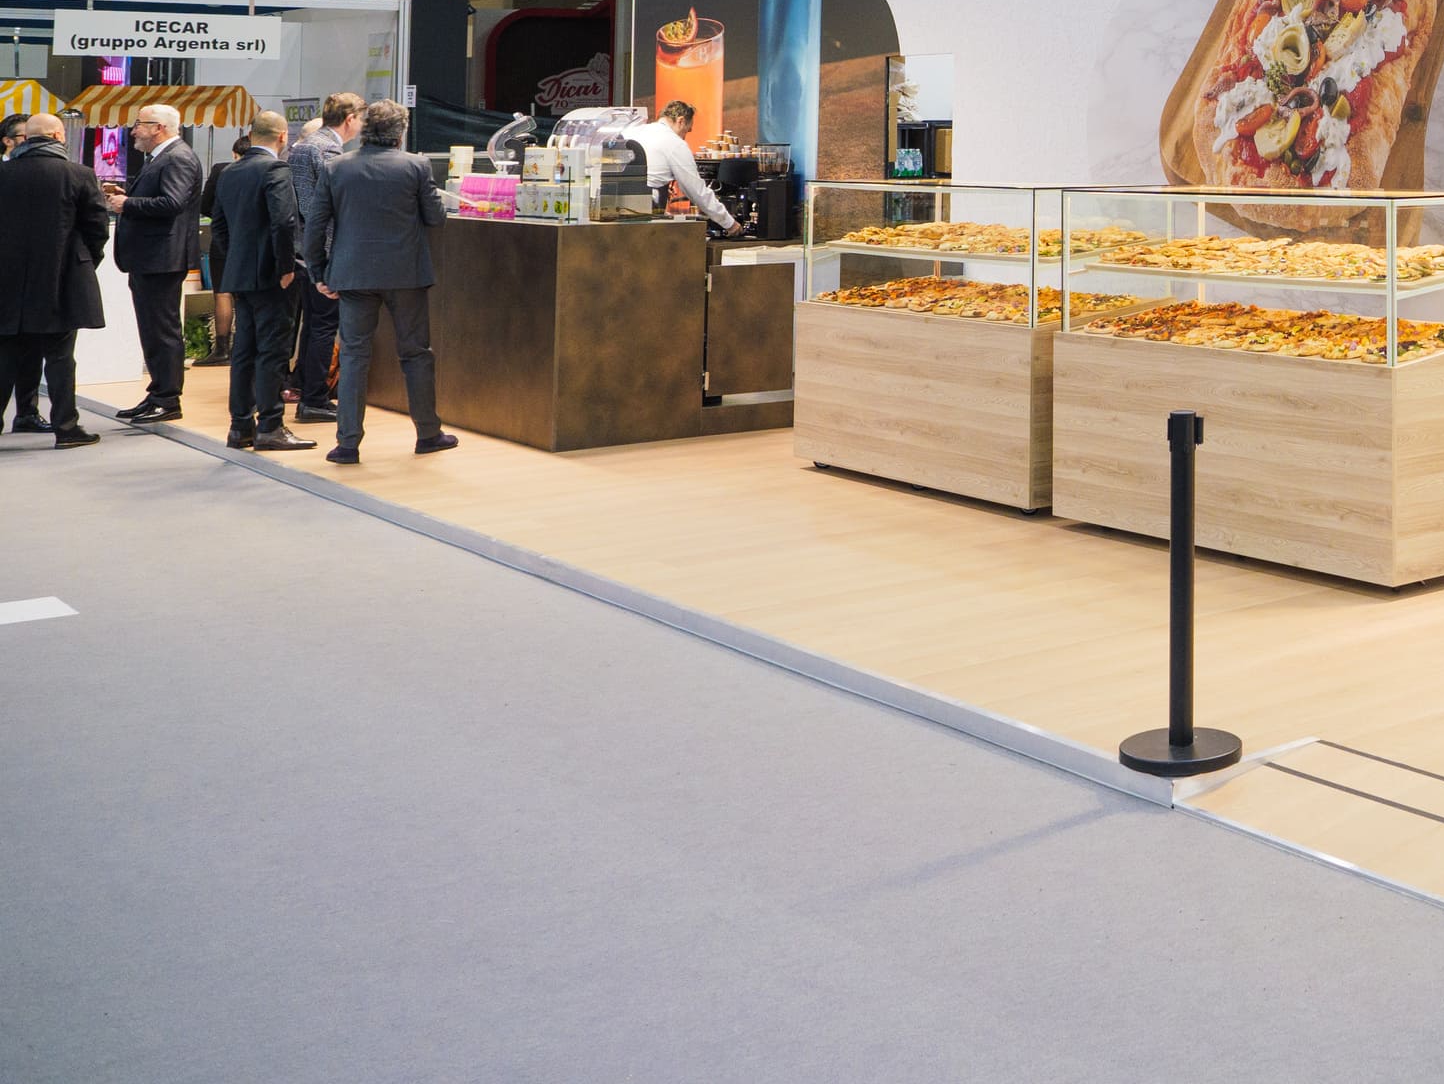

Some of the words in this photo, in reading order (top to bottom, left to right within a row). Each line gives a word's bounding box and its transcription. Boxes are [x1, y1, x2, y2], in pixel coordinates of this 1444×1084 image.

[135, 19, 209, 35] ICECAR
[70, 34, 148, 51] (gruppo
[153, 36, 230, 52] Argenta
[236, 39, 267, 54] srl)
[538, 70, 602, 104] Dicar
